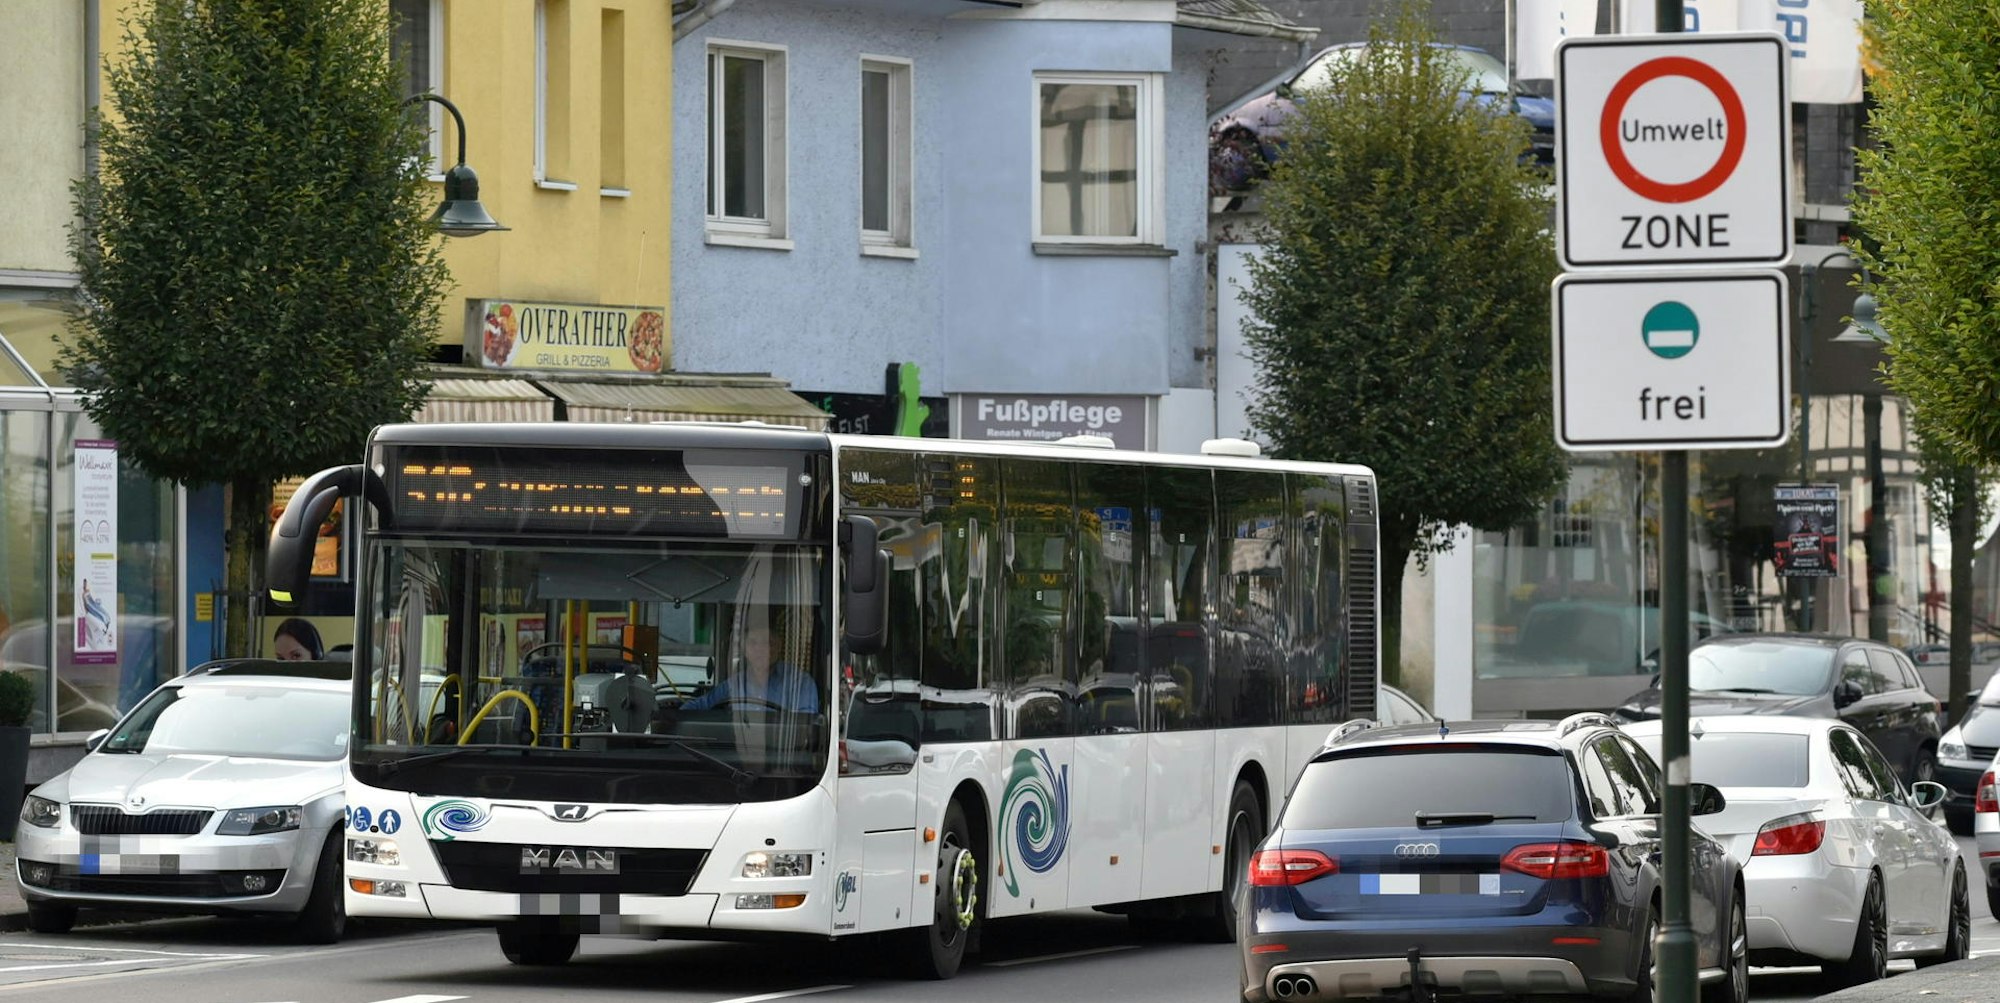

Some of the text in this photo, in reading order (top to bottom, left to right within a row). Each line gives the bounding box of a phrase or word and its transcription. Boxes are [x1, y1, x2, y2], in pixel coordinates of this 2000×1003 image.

[1622, 117, 1724, 142] Umwelt
[1621, 213, 1730, 249] ZONE
[520, 307, 627, 347] OVERATHER
[536, 353, 610, 367] GRILL & PIZZERIA
[978, 399, 1122, 428] Fußpflege
[1639, 386, 1705, 420] frei
[986, 428, 1021, 437] Renate
[1023, 428, 1063, 439] Wintgen
[851, 471, 870, 484] MAN
[521, 847, 615, 870] MAN
